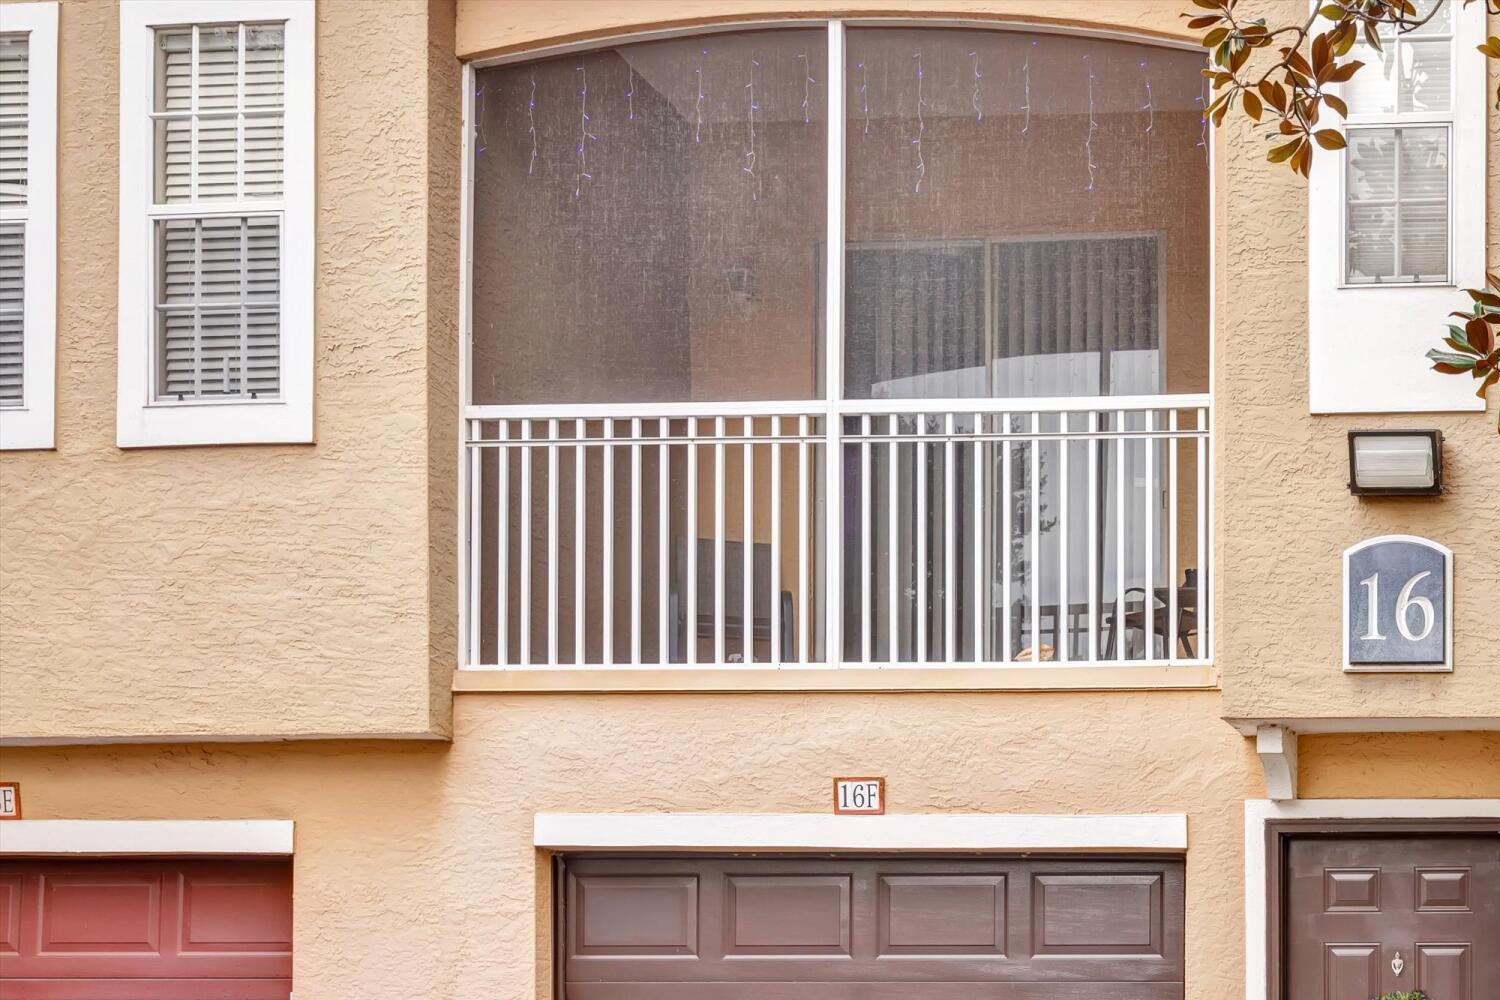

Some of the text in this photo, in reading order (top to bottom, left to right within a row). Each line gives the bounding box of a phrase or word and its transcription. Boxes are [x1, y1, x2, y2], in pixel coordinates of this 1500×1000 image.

[1359, 570, 1435, 642] 16
[0, 789, 14, 813] E
[840, 783, 878, 808] 16F
